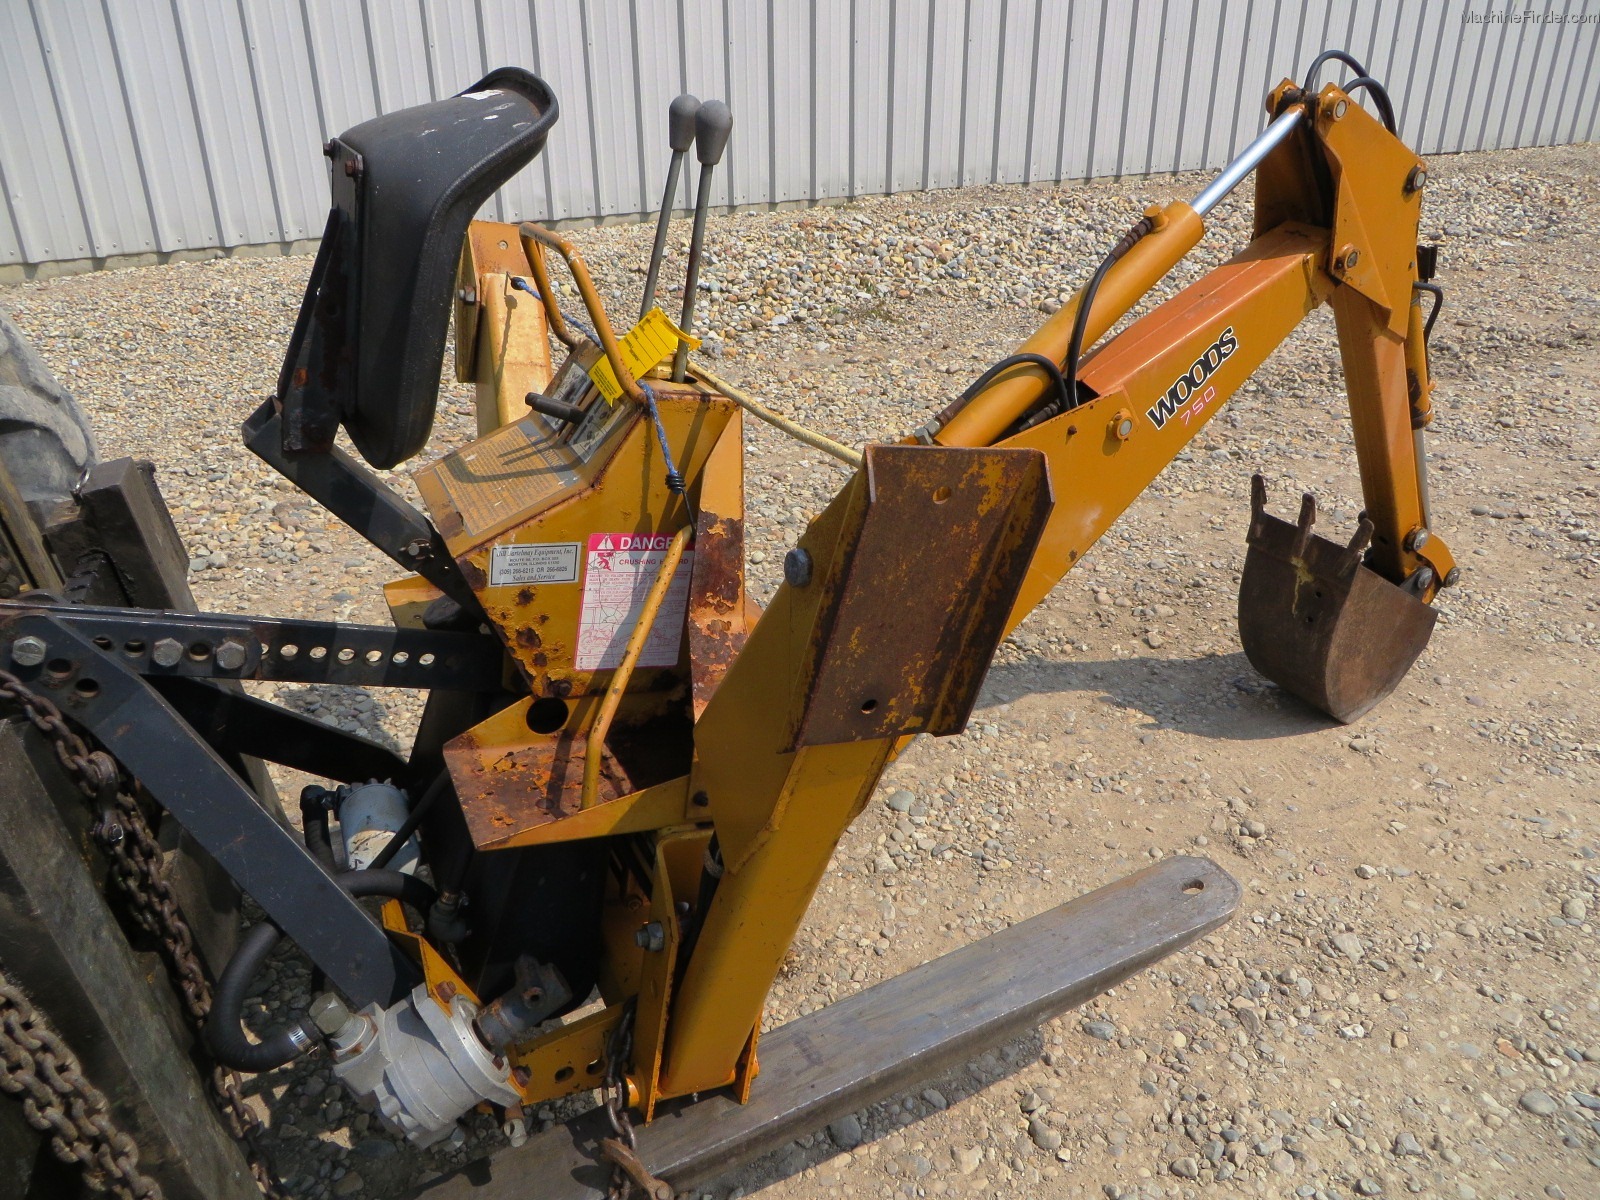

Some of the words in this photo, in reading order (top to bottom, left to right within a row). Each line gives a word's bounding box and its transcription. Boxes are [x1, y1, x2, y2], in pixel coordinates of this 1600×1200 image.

[1145, 326, 1238, 430] WOODS
[1180, 386, 1216, 425] 750
[534, 548, 563, 557] Equipment,
[619, 536, 674, 550] DANGE
